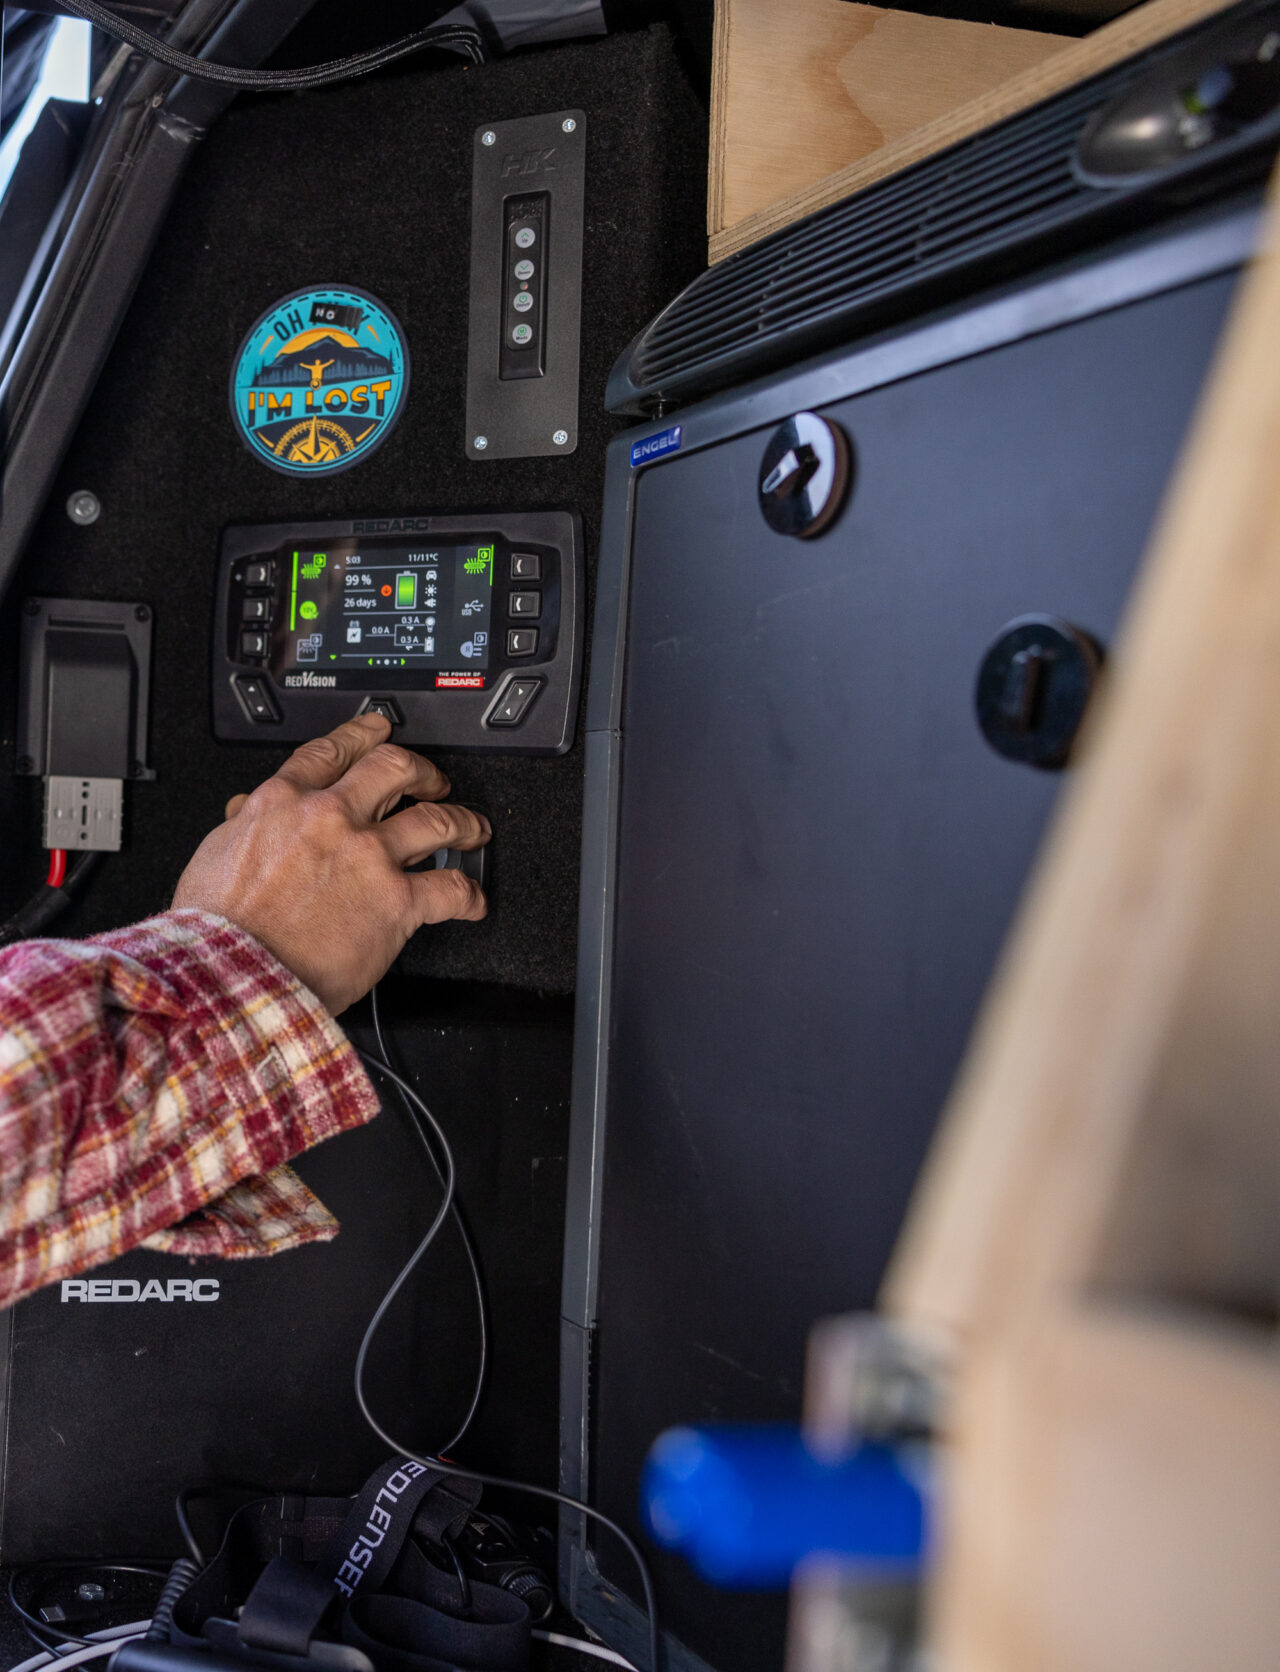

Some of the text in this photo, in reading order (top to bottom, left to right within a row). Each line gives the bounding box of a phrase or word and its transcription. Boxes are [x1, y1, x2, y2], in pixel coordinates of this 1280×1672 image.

[273, 309, 305, 341] OH
[248, 380, 392, 428] I'M LOST
[632, 435, 678, 460] ENGEL
[353, 518, 429, 534] REDARC
[345, 574, 372, 586] 99 %
[344, 598, 377, 609] 26 days
[401, 616, 413, 624] 0.3
[371, 626, 384, 634] 0.0
[400, 636, 412, 644] 0.3
[437, 677, 481, 686] REDARC
[61, 1279, 220, 1302] REDARC
[333, 1456, 432, 1598] EDLENSE
